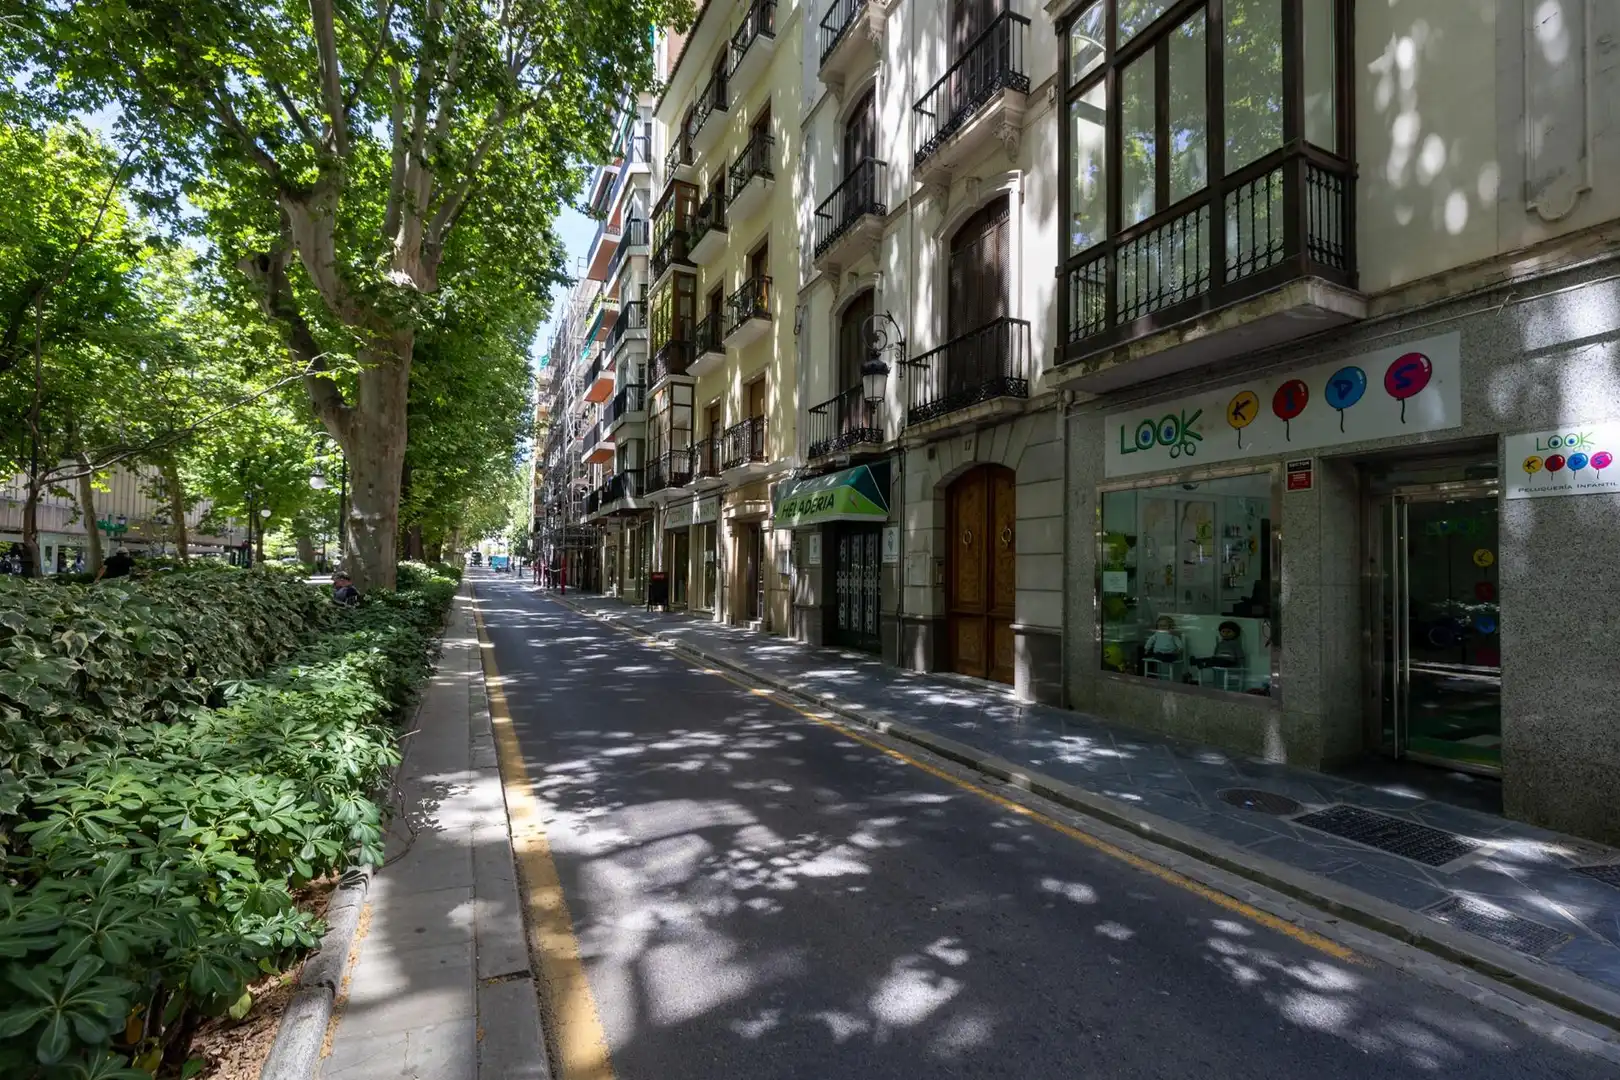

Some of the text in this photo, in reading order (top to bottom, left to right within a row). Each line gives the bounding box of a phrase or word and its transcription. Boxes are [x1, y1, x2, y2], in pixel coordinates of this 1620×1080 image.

[1120, 409, 1203, 458] LOOK
[1536, 432, 1595, 453] LOOK
[781, 493, 834, 518] HELADERIA
